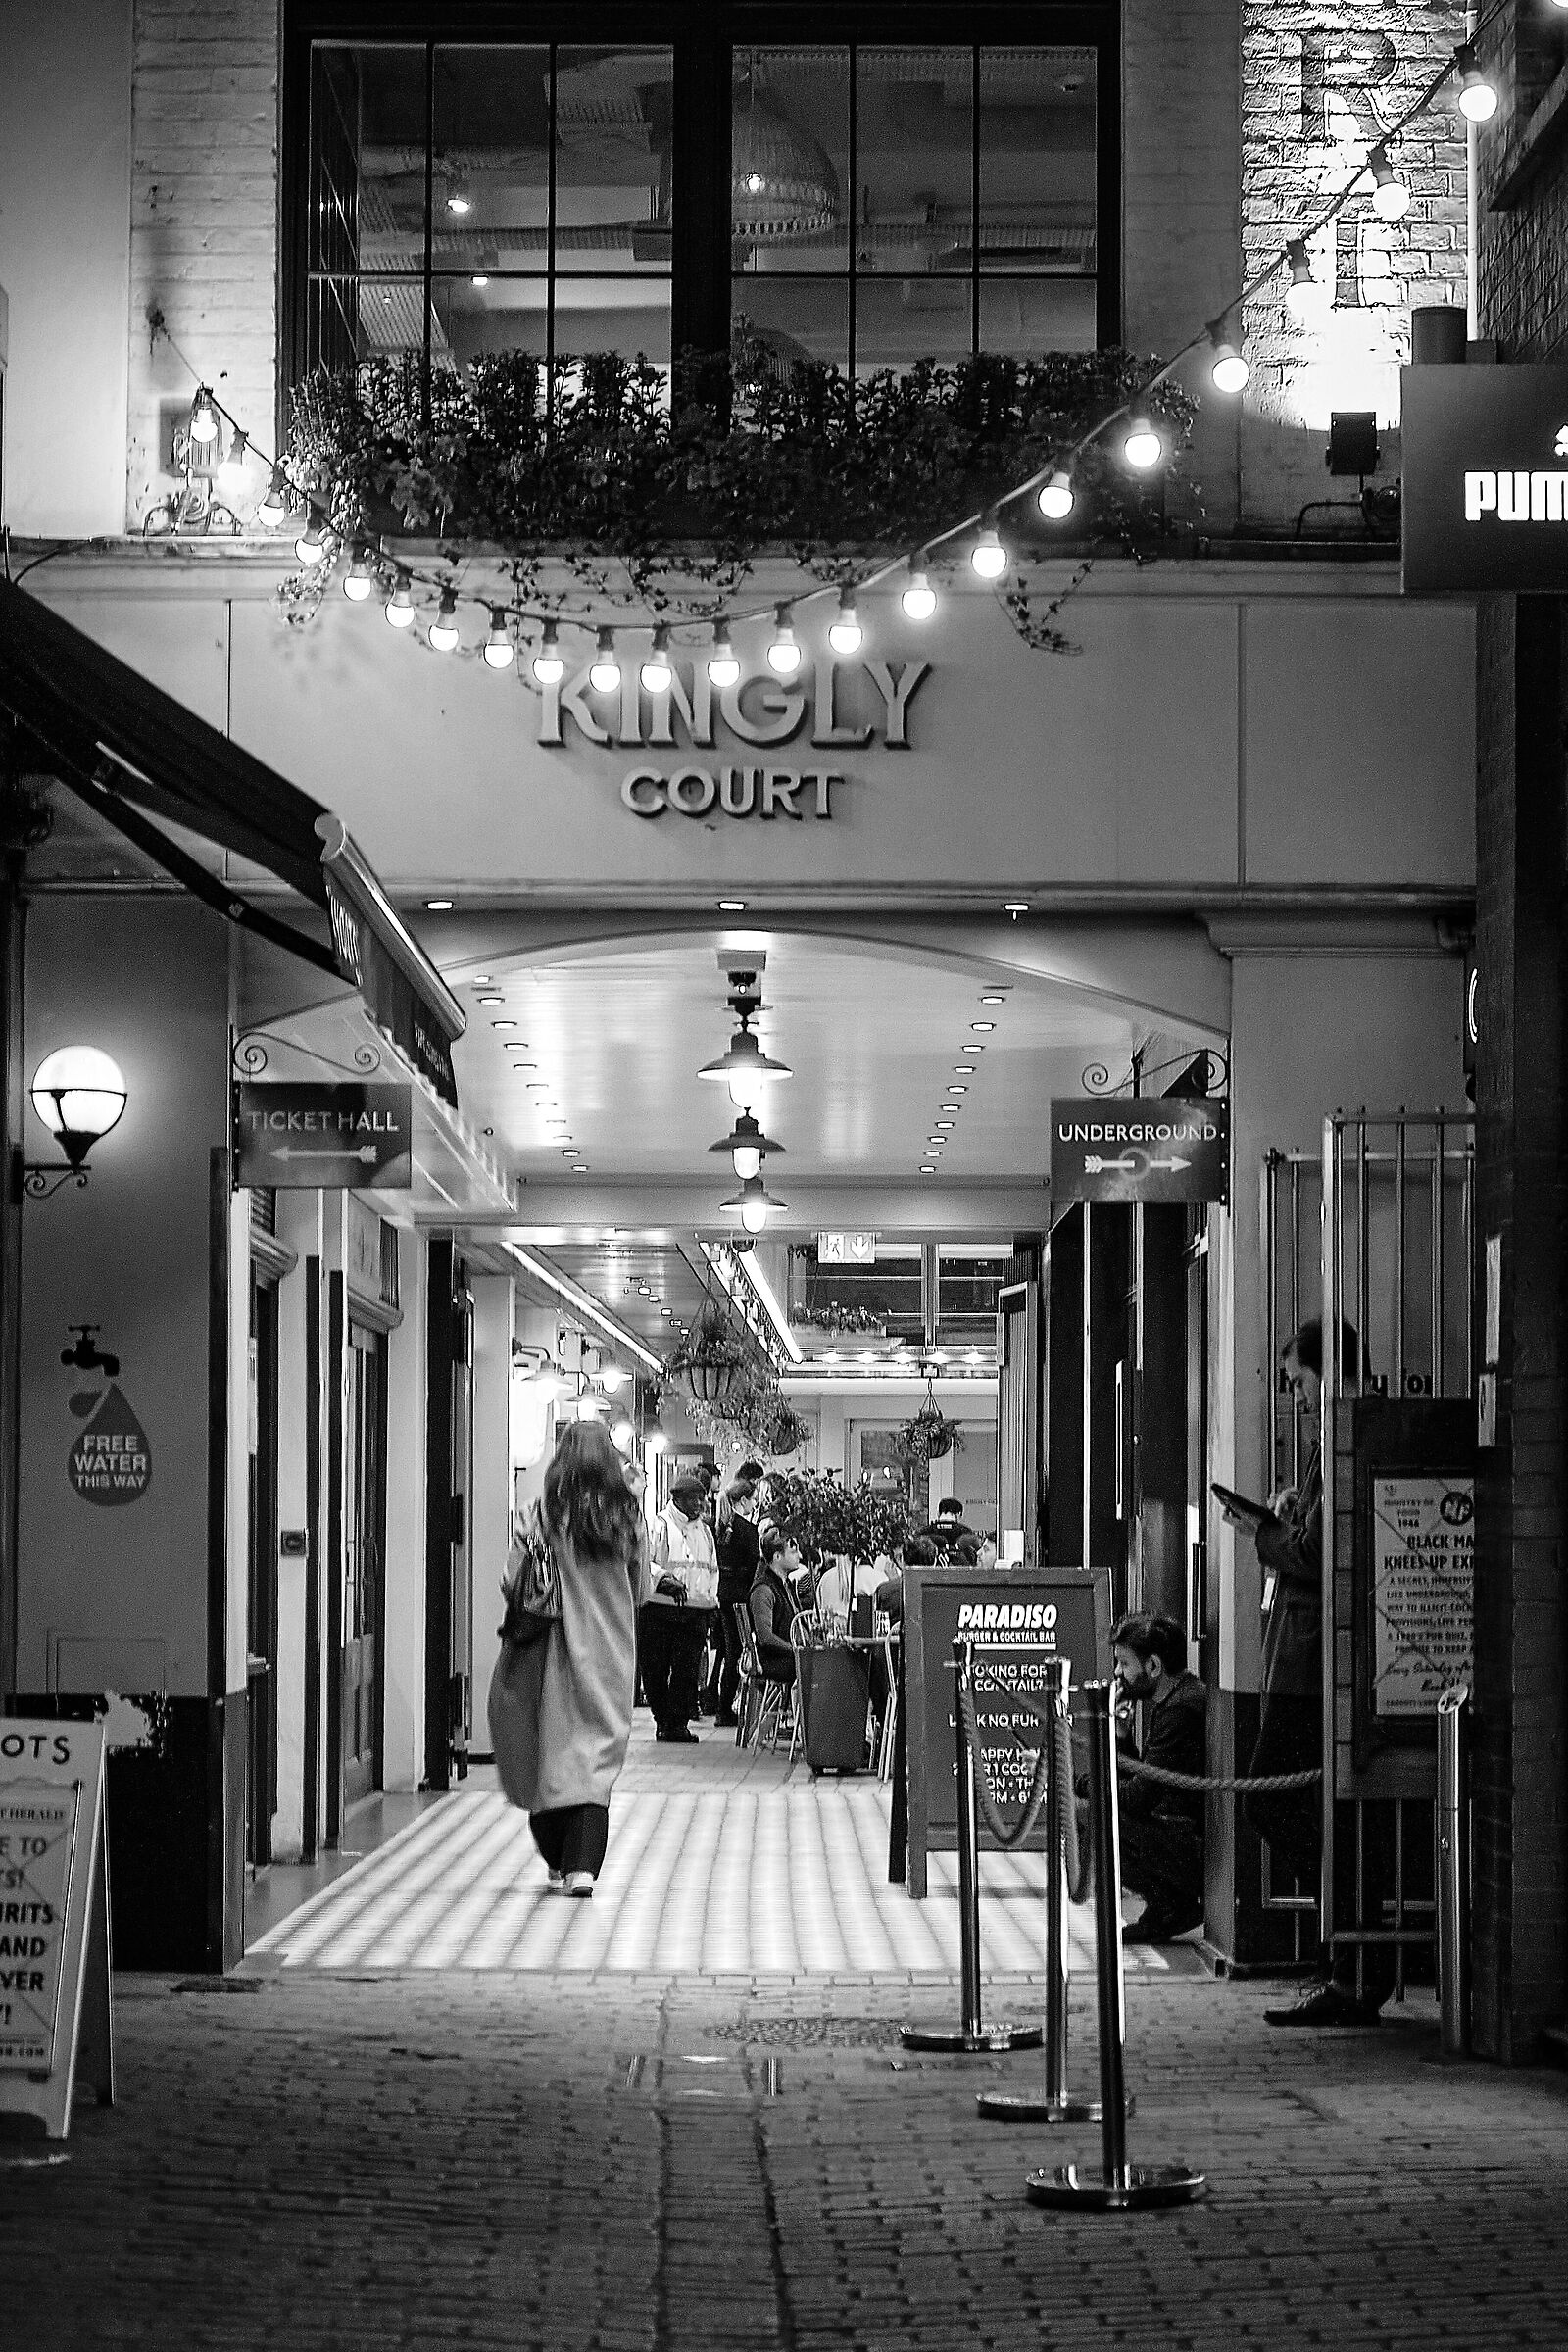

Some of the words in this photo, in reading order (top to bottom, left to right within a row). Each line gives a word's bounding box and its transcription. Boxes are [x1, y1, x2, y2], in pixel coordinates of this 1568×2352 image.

[537, 659, 933, 749] KINGLY
[620, 766, 845, 819] COURT
[247, 1111, 331, 1130] TICKET
[338, 1111, 400, 1131] HALL
[1058, 1124, 1217, 1142] UNDERGROUND
[84, 1435, 137, 1452] FREE
[74, 1454, 146, 1472] WATER
[76, 1474, 110, 1488] THIS
[113, 1474, 145, 1489] WAY
[1407, 1535, 1449, 1549] BLACK
[958, 1604, 1057, 1629] PARADISO
[1000, 1631, 1038, 1642] COCKTAIL
[1039, 1631, 1056, 1642] BAR
[988, 1714, 1009, 1728] NO
[0, 1734, 71, 1765] OTS
[19, 1836, 48, 1857] TO
